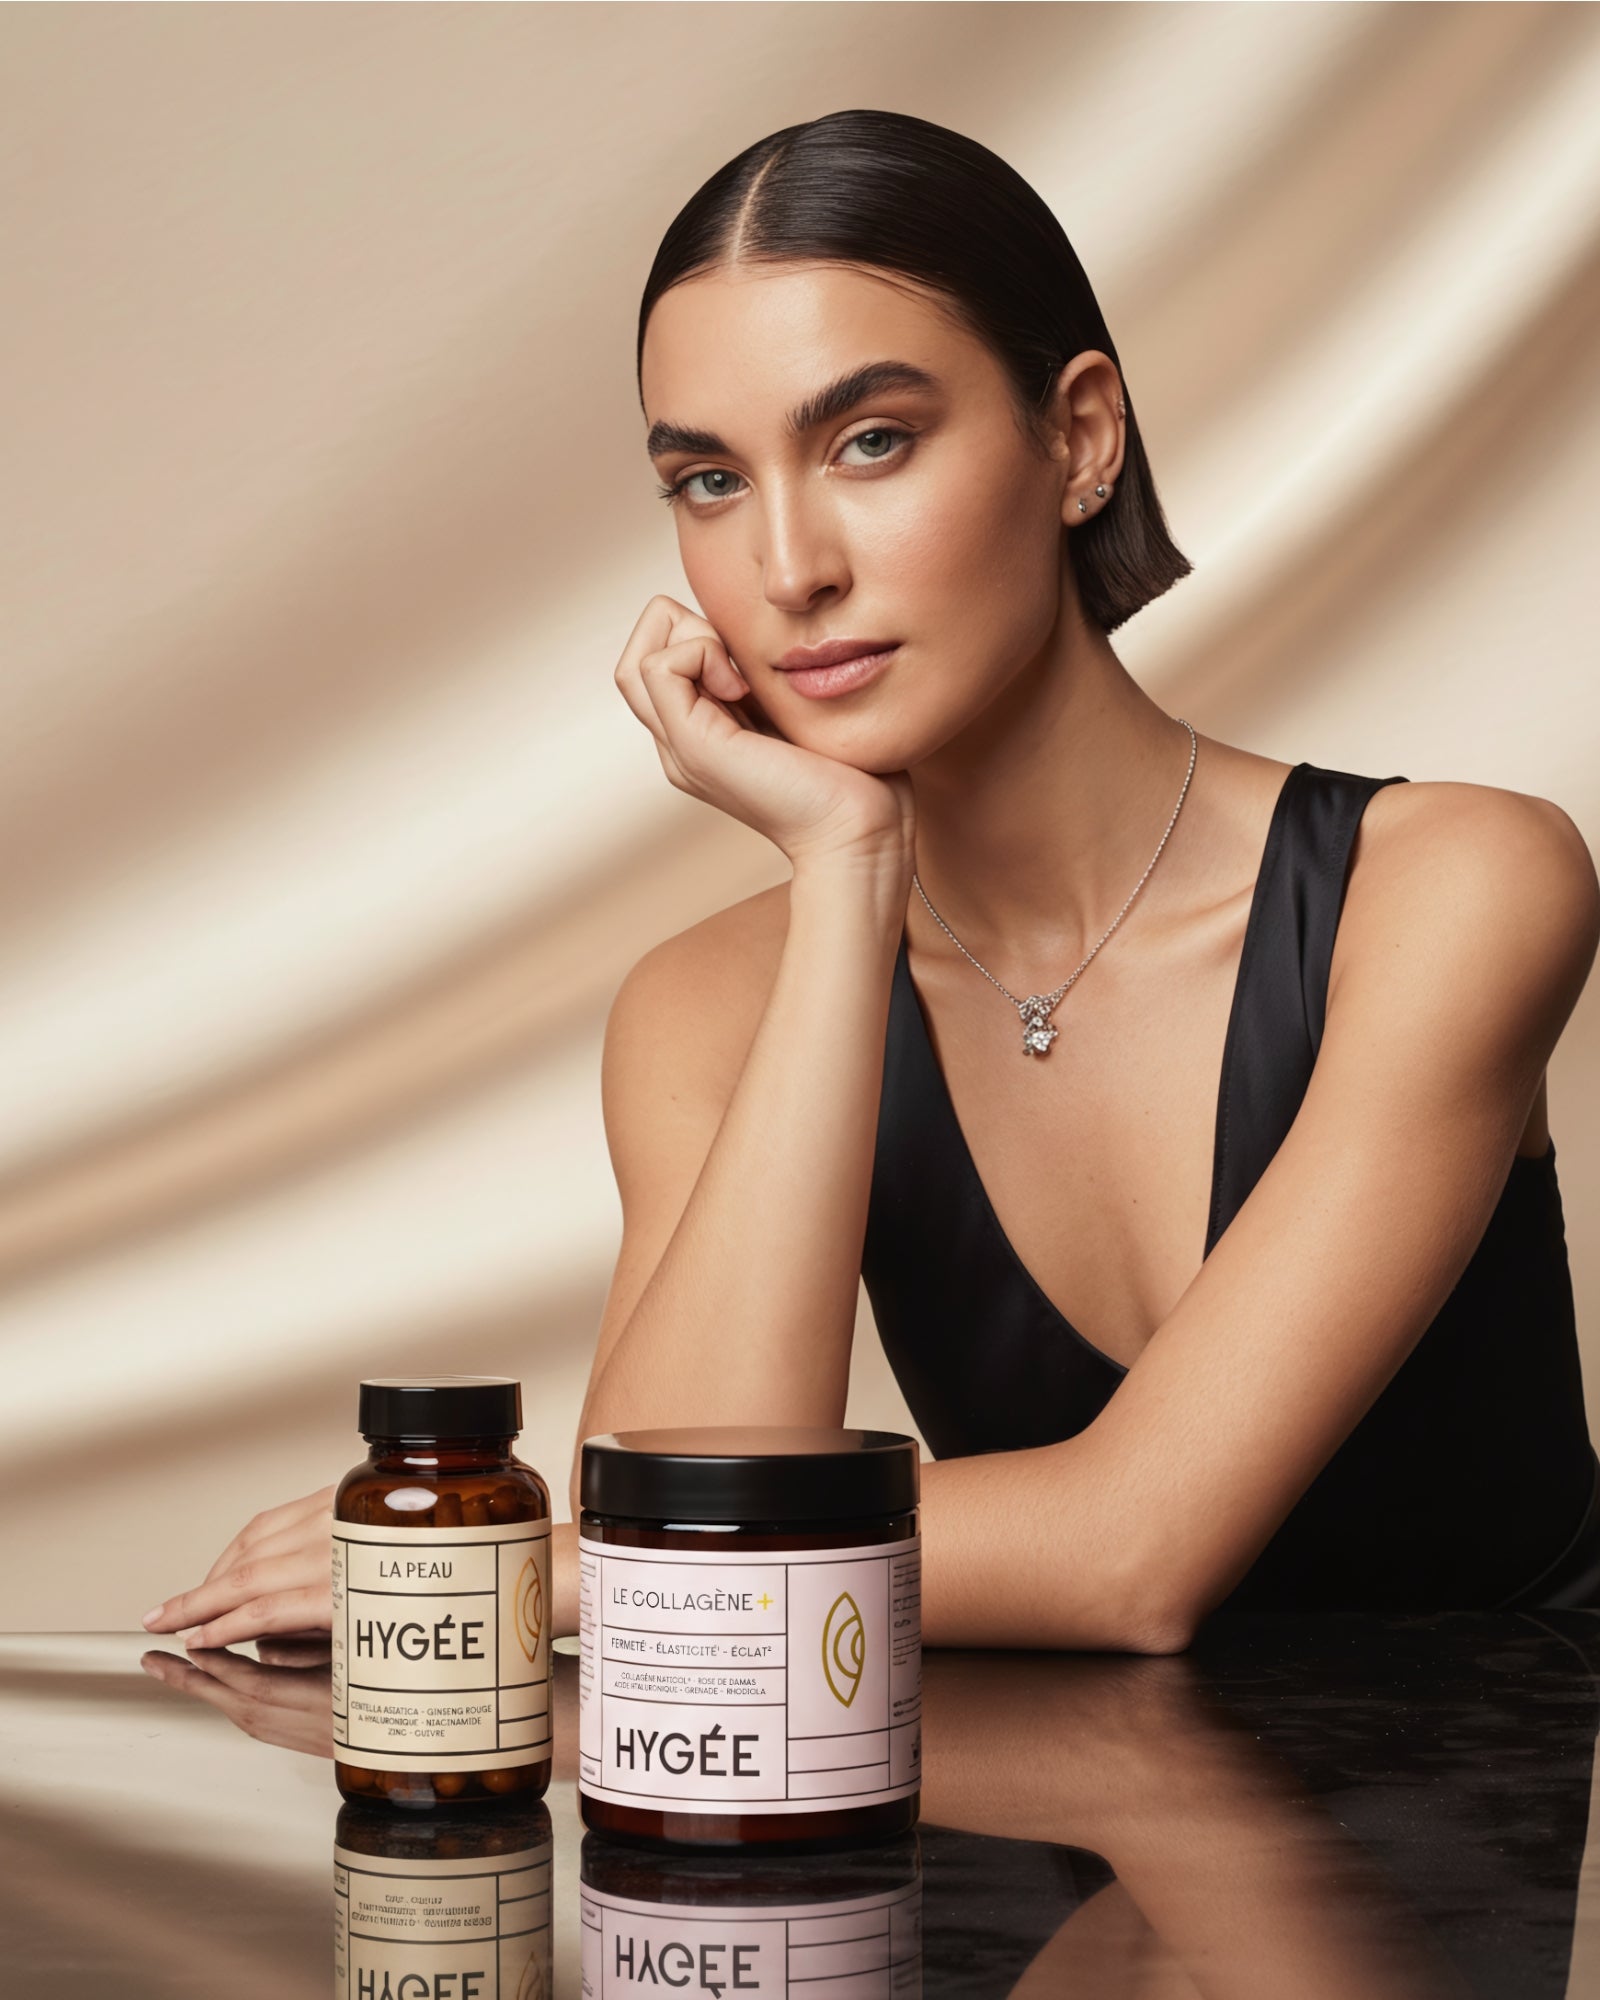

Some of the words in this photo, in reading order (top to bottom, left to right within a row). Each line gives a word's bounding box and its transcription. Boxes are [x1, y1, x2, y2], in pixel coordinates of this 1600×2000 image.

[380, 1561, 401, 1578] LA
[406, 1562, 453, 1578] PEAU
[613, 1587, 628, 1605] LE
[357, 1614, 485, 1661] HYGÉE
[729, 1678, 757, 1686] DAMAS
[684, 1686, 719, 1695] GRENADE
[350, 1701, 382, 1713] CENTELLA
[426, 1707, 464, 1716] GINSENG
[465, 1704, 492, 1715] ROUGE
[426, 1716, 482, 1727] NIACINAMIDE
[388, 1727, 407, 1736] ZINC
[616, 1723, 761, 1777] HYGÉE
